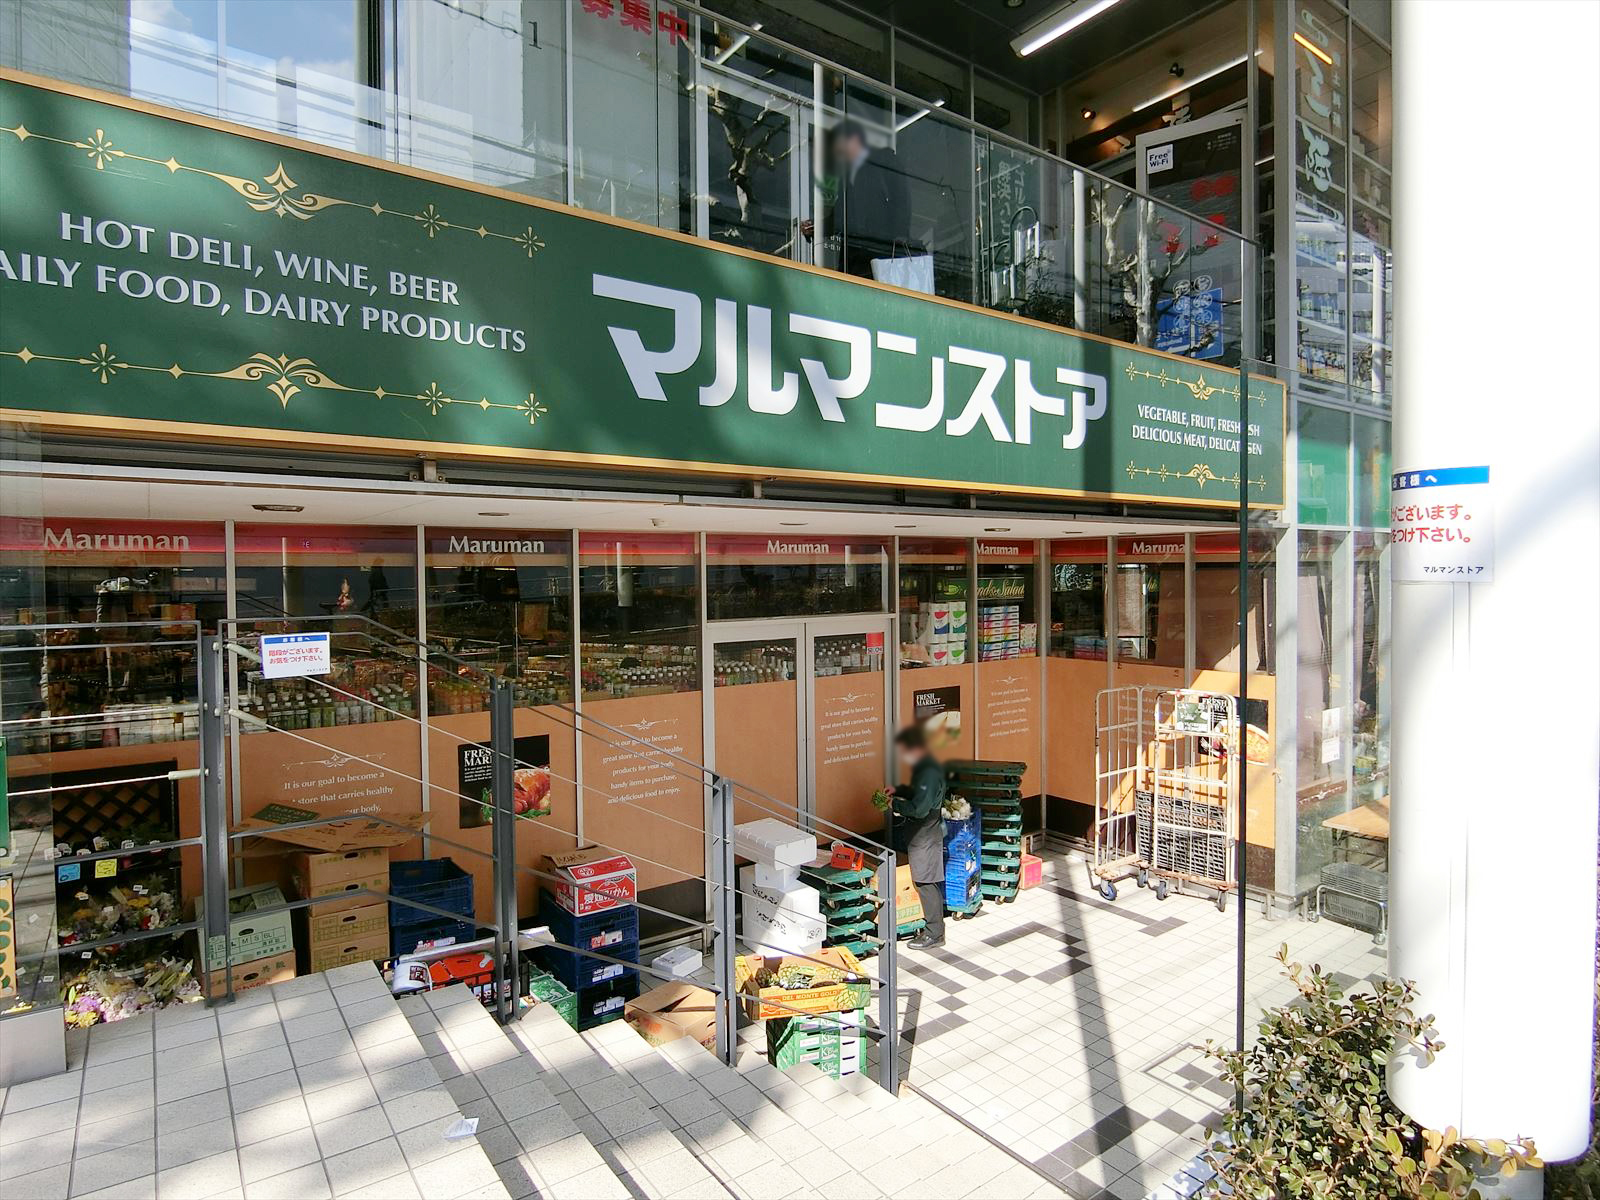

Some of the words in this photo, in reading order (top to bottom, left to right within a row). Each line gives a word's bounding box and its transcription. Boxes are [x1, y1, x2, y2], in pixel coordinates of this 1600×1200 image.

[1149, 152, 1168, 161] Free
[1149, 158, 1169, 168] Wi-Fi
[60, 212, 155, 254] HOT
[169, 230, 265, 278] DELI,
[273, 249, 379, 298] WINE,
[389, 272, 460, 306] BEER
[96, 265, 232, 317] FOOD,
[244, 287, 351, 329] DAIRY
[361, 306, 528, 354] PRODUCTS
[592, 272, 1108, 450] マルマンストア
[1137, 403, 1189, 428] VEGETABLE,
[1190, 413, 1216, 432] FRUIT,
[1217, 418, 1241, 434] FRESH
[1132, 424, 1181, 445] DELICIOUS
[1183, 432, 1208, 451] MEAT,
[43, 527, 190, 550] Maruman
[449, 535, 545, 555] Maruman
[767, 540, 830, 555] Maruman
[976, 542, 1019, 556] Maruman
[1132, 541, 1185, 554] Maruma
[1423, 565, 1485, 575] マルマンストア
[916, 692, 935, 701] FRESH
[916, 698, 941, 706] MARKET
[464, 748, 492, 759] FRES
[602, 756, 618, 765] great
[619, 753, 632, 761] store
[664, 746, 684, 754] healthy
[612, 767, 637, 777] products
[647, 763, 660, 771] your
[284, 782, 291, 790] It
[292, 781, 301, 789] is
[301, 781, 317, 789] our
[317, 775, 335, 788] goal
[337, 775, 346, 783] to
[347, 772, 378, 782] become
[610, 782, 628, 790] handy
[320, 793, 337, 803] that
[337, 788, 365, 800] carries
[366, 785, 395, 797] healthy
[619, 793, 644, 802] delicious
[782, 994, 795, 1002] DEL
[796, 989, 820, 1000] MONTE
[820, 987, 838, 997] GOLD
